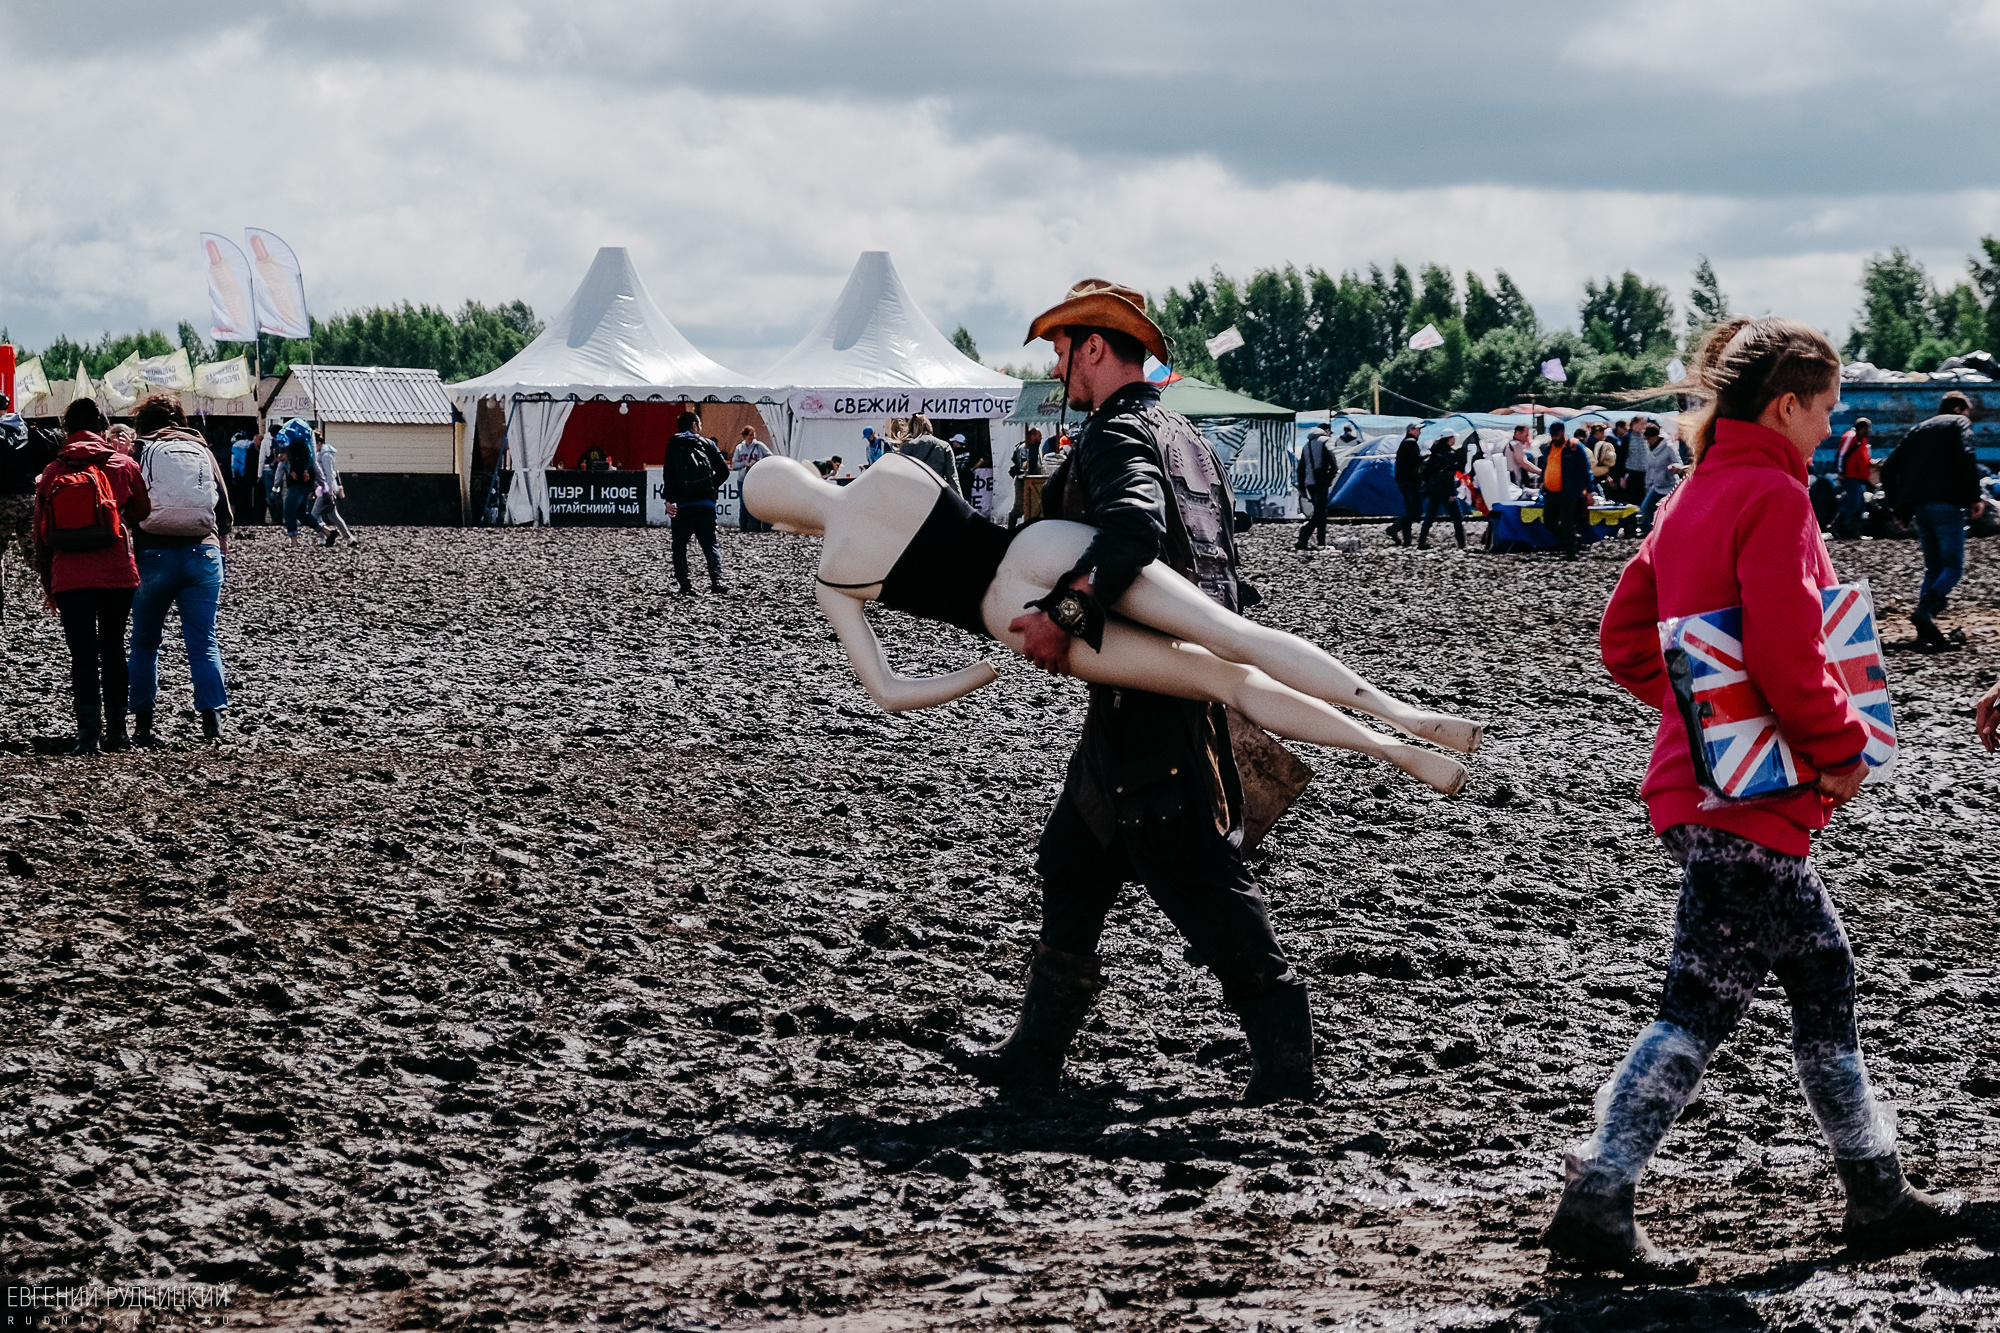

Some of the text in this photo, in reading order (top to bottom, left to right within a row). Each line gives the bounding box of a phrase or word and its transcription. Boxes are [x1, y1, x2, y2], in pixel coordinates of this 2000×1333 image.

[834, 393, 1013, 414] СВЕЖИЙ КИПЯТОЧЕ
[549, 486, 583, 499] ПУЭР
[601, 486, 638, 499] КОФЕ
[618, 501, 640, 514] ЧАЙ
